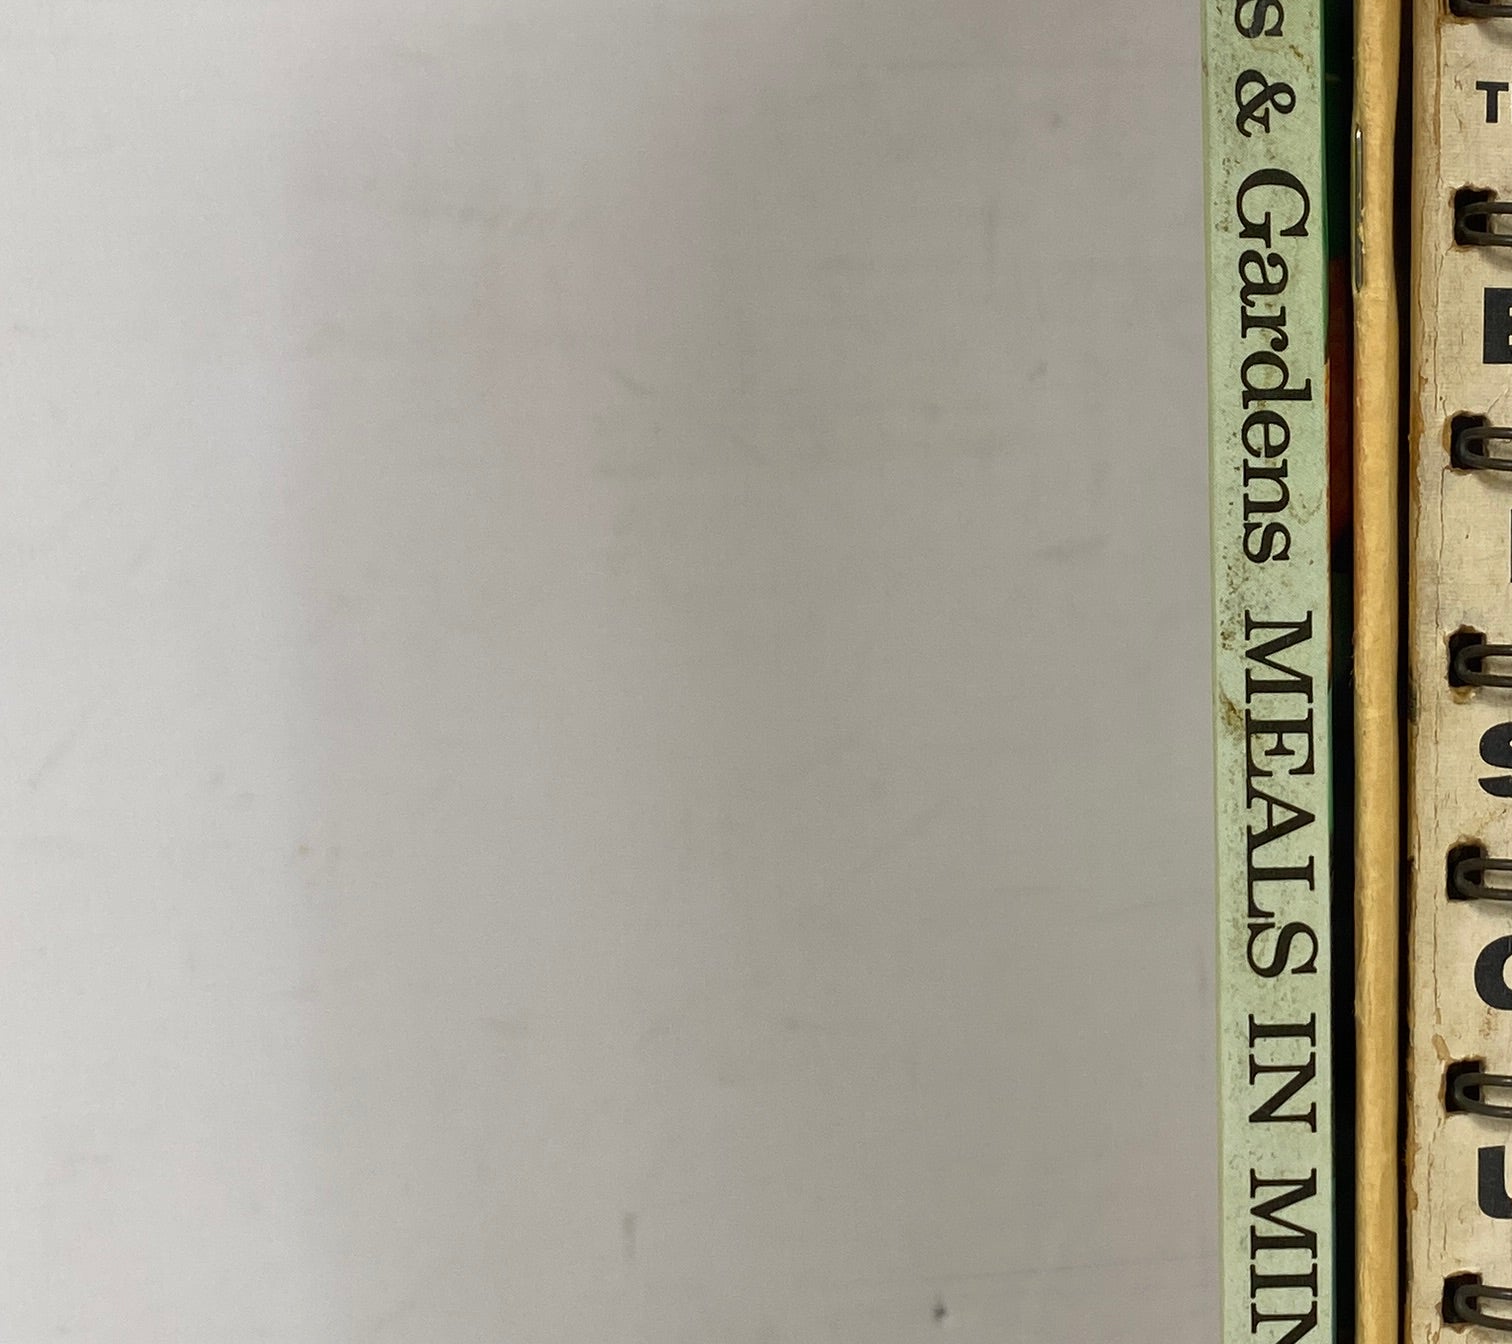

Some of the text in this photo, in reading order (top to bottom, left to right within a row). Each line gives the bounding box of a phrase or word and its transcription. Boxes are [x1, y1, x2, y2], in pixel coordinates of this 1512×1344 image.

[1234, 67, 1297, 139] &
[1236, 168, 1312, 564] Gardens
[1244, 609, 1320, 978] MEALS
[1247, 1012, 1317, 1133] IN
